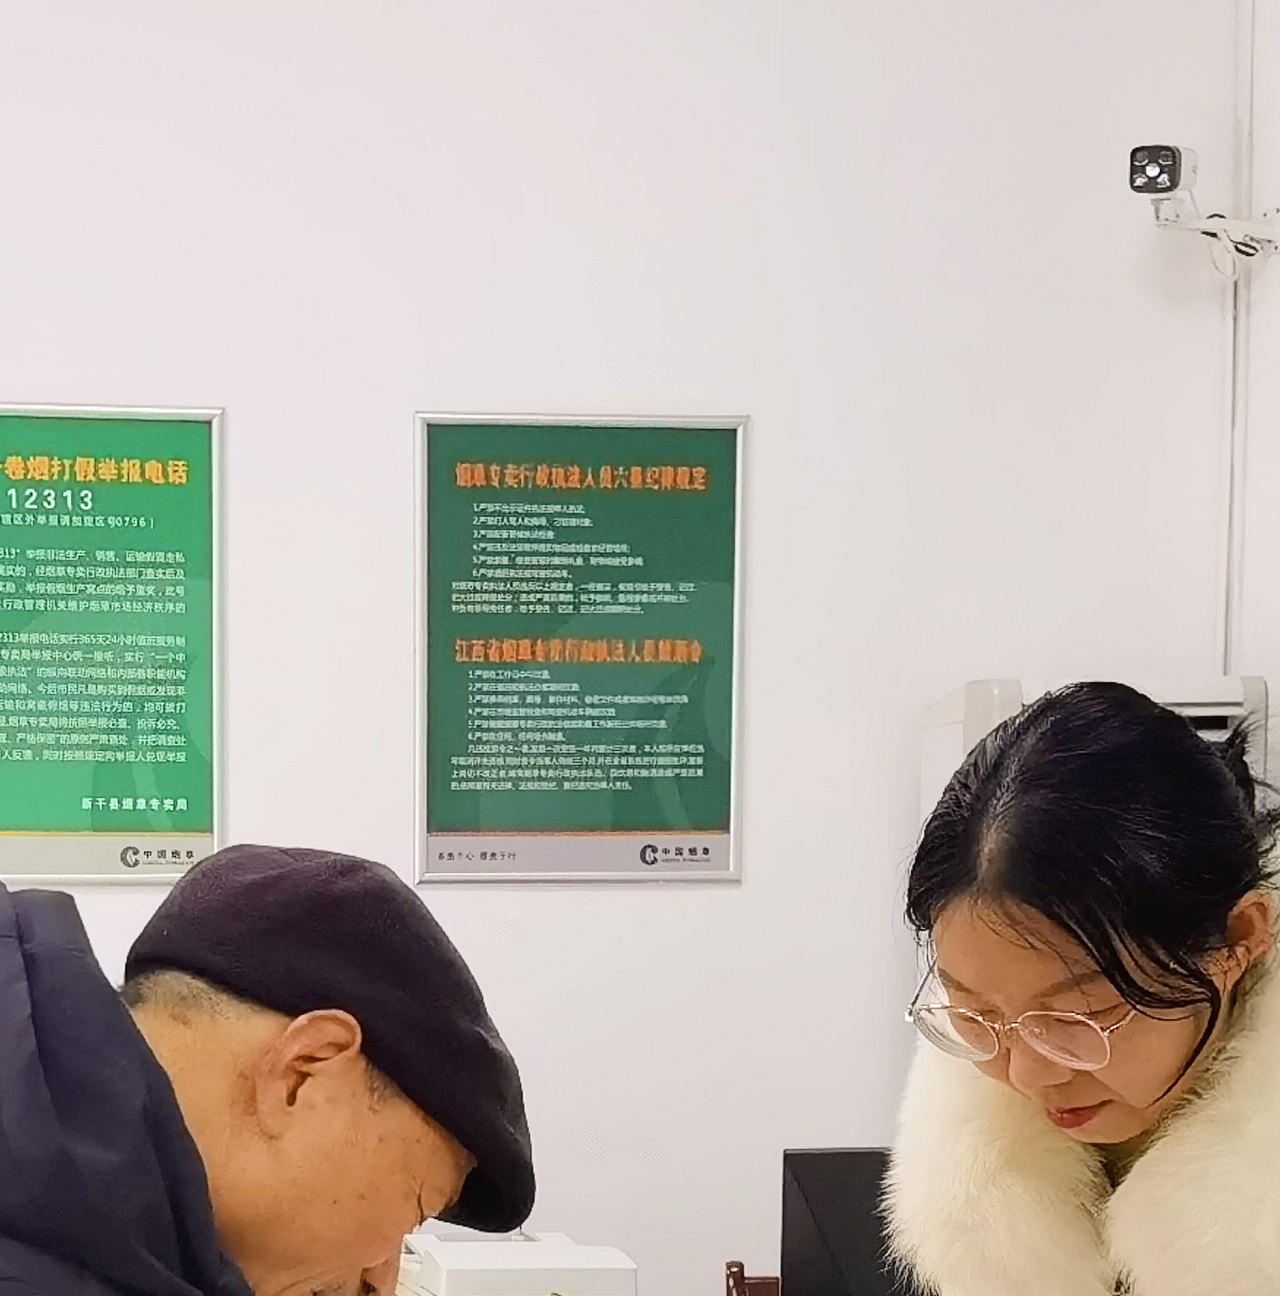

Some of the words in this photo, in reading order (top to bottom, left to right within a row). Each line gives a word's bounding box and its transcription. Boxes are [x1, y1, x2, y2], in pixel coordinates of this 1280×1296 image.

[7, 488, 94, 511] 12313
[81, 797, 189, 811] 新干县烟草专卖局
